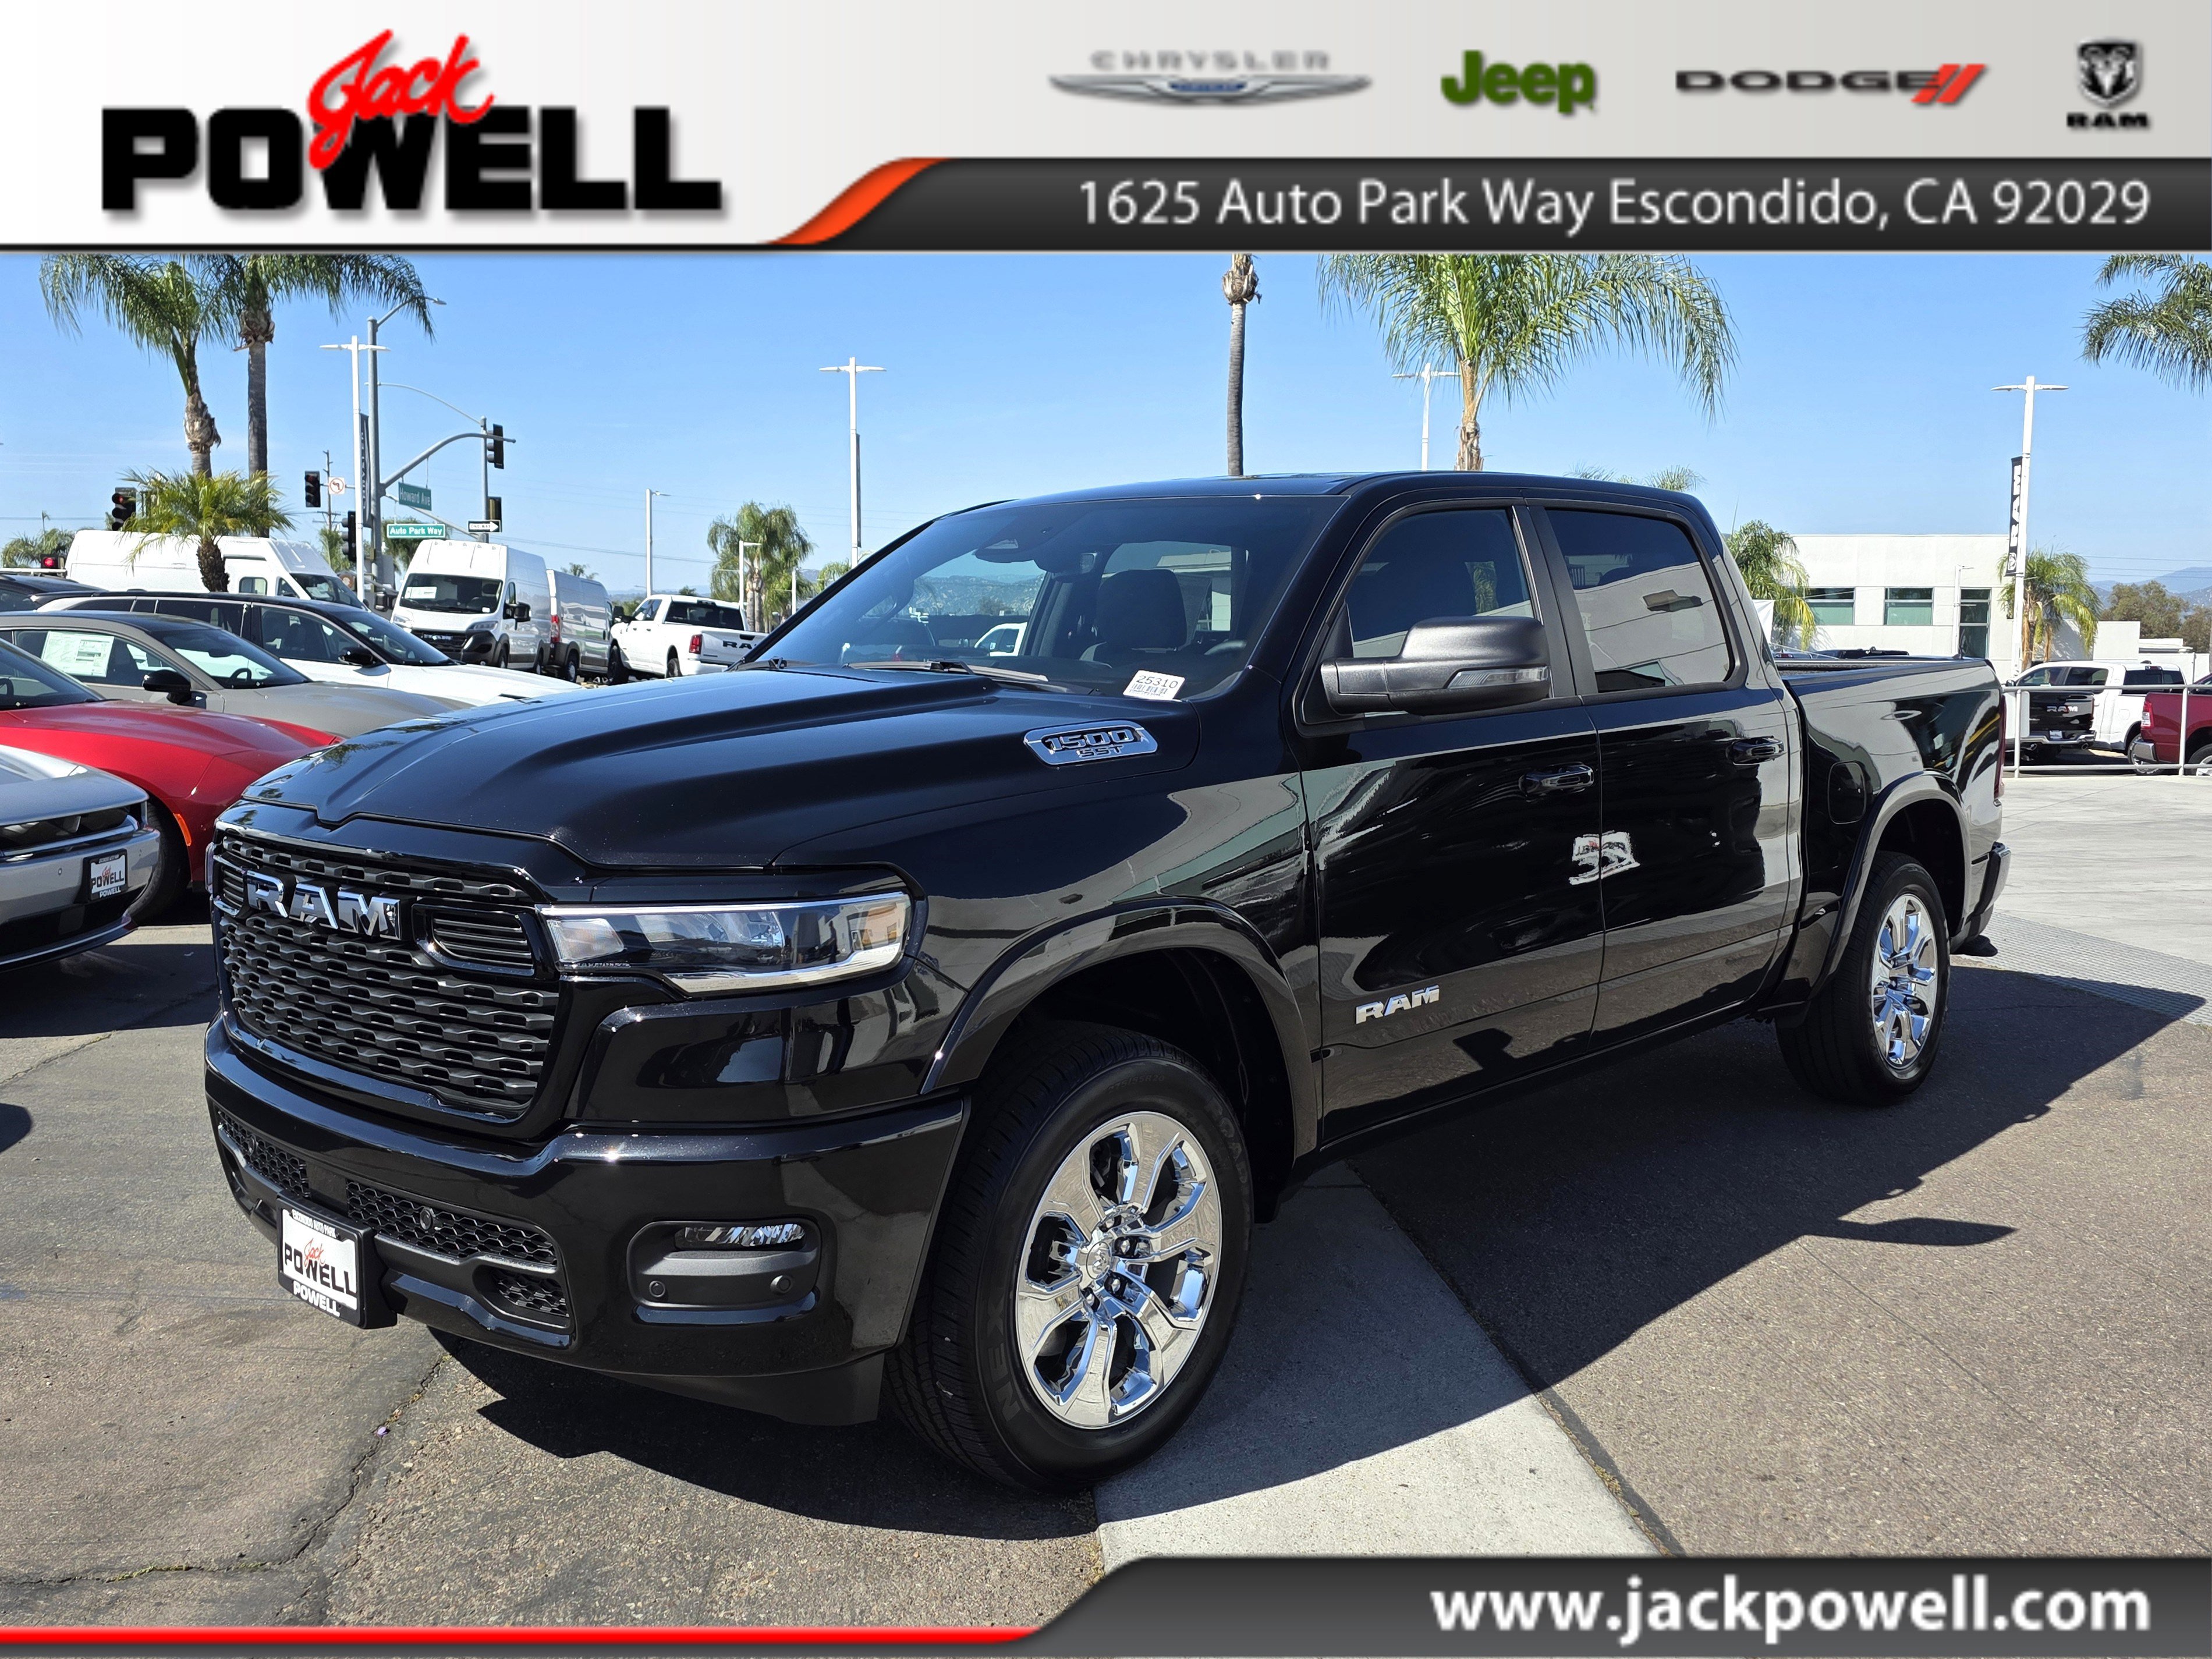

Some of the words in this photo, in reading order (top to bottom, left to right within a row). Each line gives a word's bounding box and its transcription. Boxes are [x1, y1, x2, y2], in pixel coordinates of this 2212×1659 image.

[400, 487, 420, 506] Howard
[421, 492, 431, 506] Ave
[2010, 465, 2022, 547] RAM
[389, 527, 407, 535] Auto
[409, 526, 426, 534] Park
[427, 526, 442, 536] Way
[722, 640, 757, 650] RA
[1136, 675, 1179, 689] 25310
[1045, 729, 1135, 753] 1500
[1077, 745, 1123, 758] SST
[91, 870, 125, 888] POWELL
[100, 886, 121, 899] POWELL
[246, 870, 402, 941] RAM
[1356, 984, 1440, 1025] RAM
[304, 1238, 325, 1268] Jack
[285, 1242, 356, 1296] POWELL
[293, 1280, 341, 1317] POWELL
